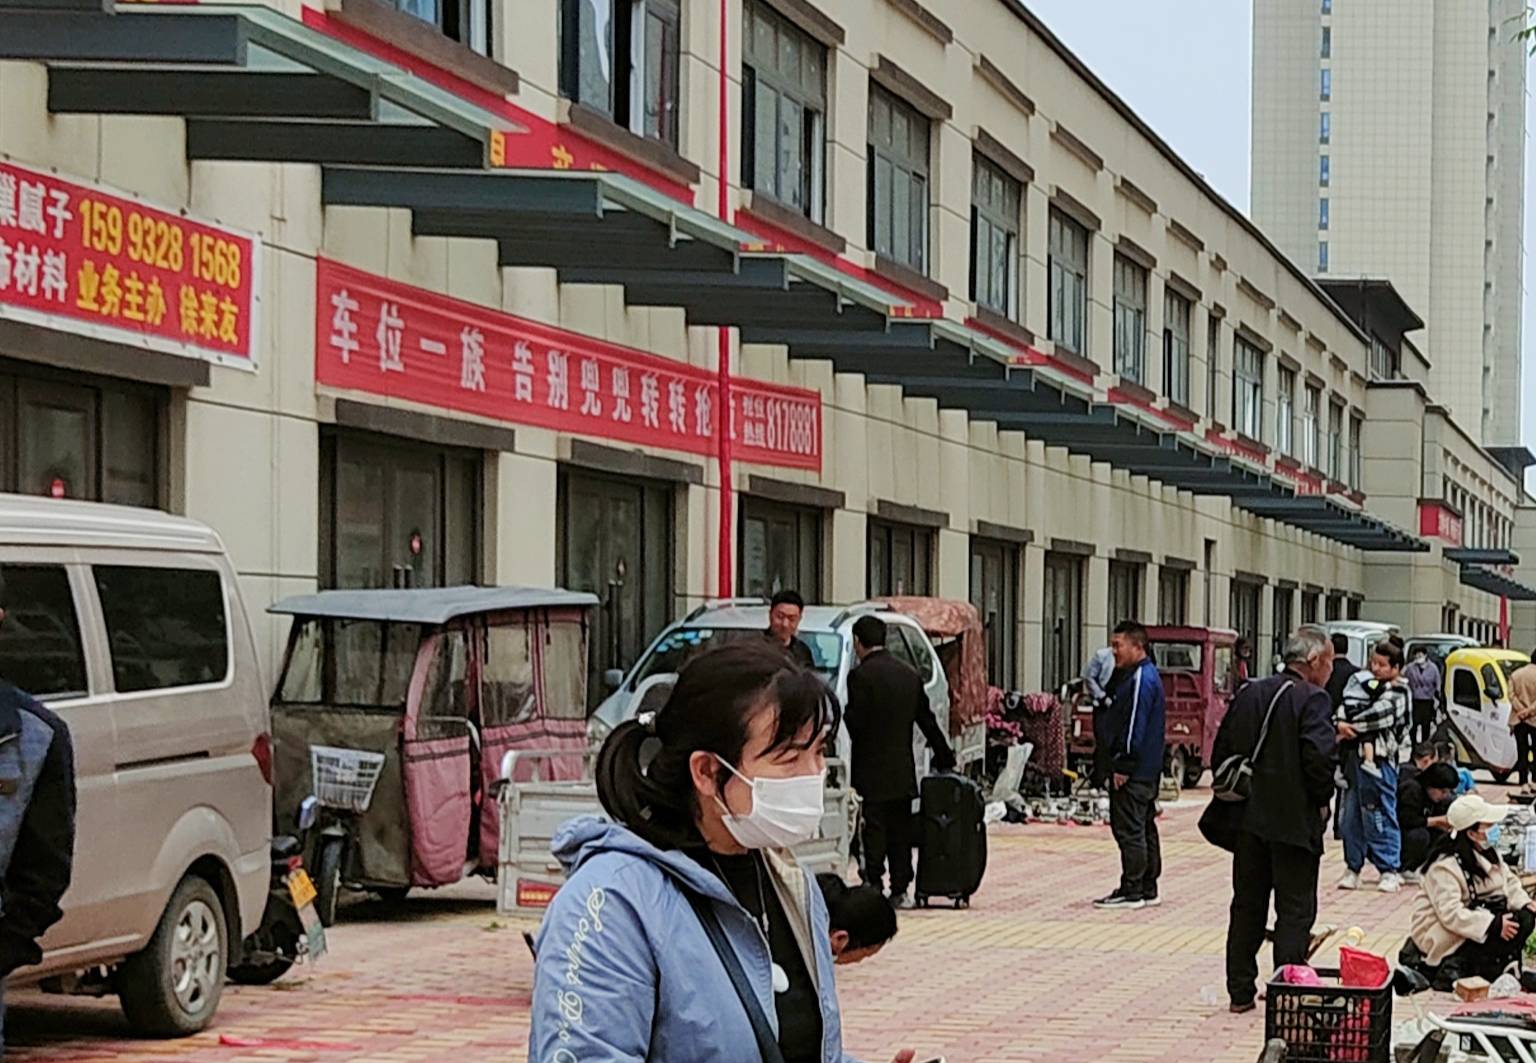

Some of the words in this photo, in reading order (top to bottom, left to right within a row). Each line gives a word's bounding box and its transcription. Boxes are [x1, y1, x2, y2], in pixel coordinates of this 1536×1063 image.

[79, 198, 123, 256] 159
[127, 212, 184, 273] 9328
[189, 231, 242, 289] 1568
[76, 258, 168, 327] 业务主办
[330, 288, 486, 393] 车位一族
[766, 397, 819, 457] 8178881
